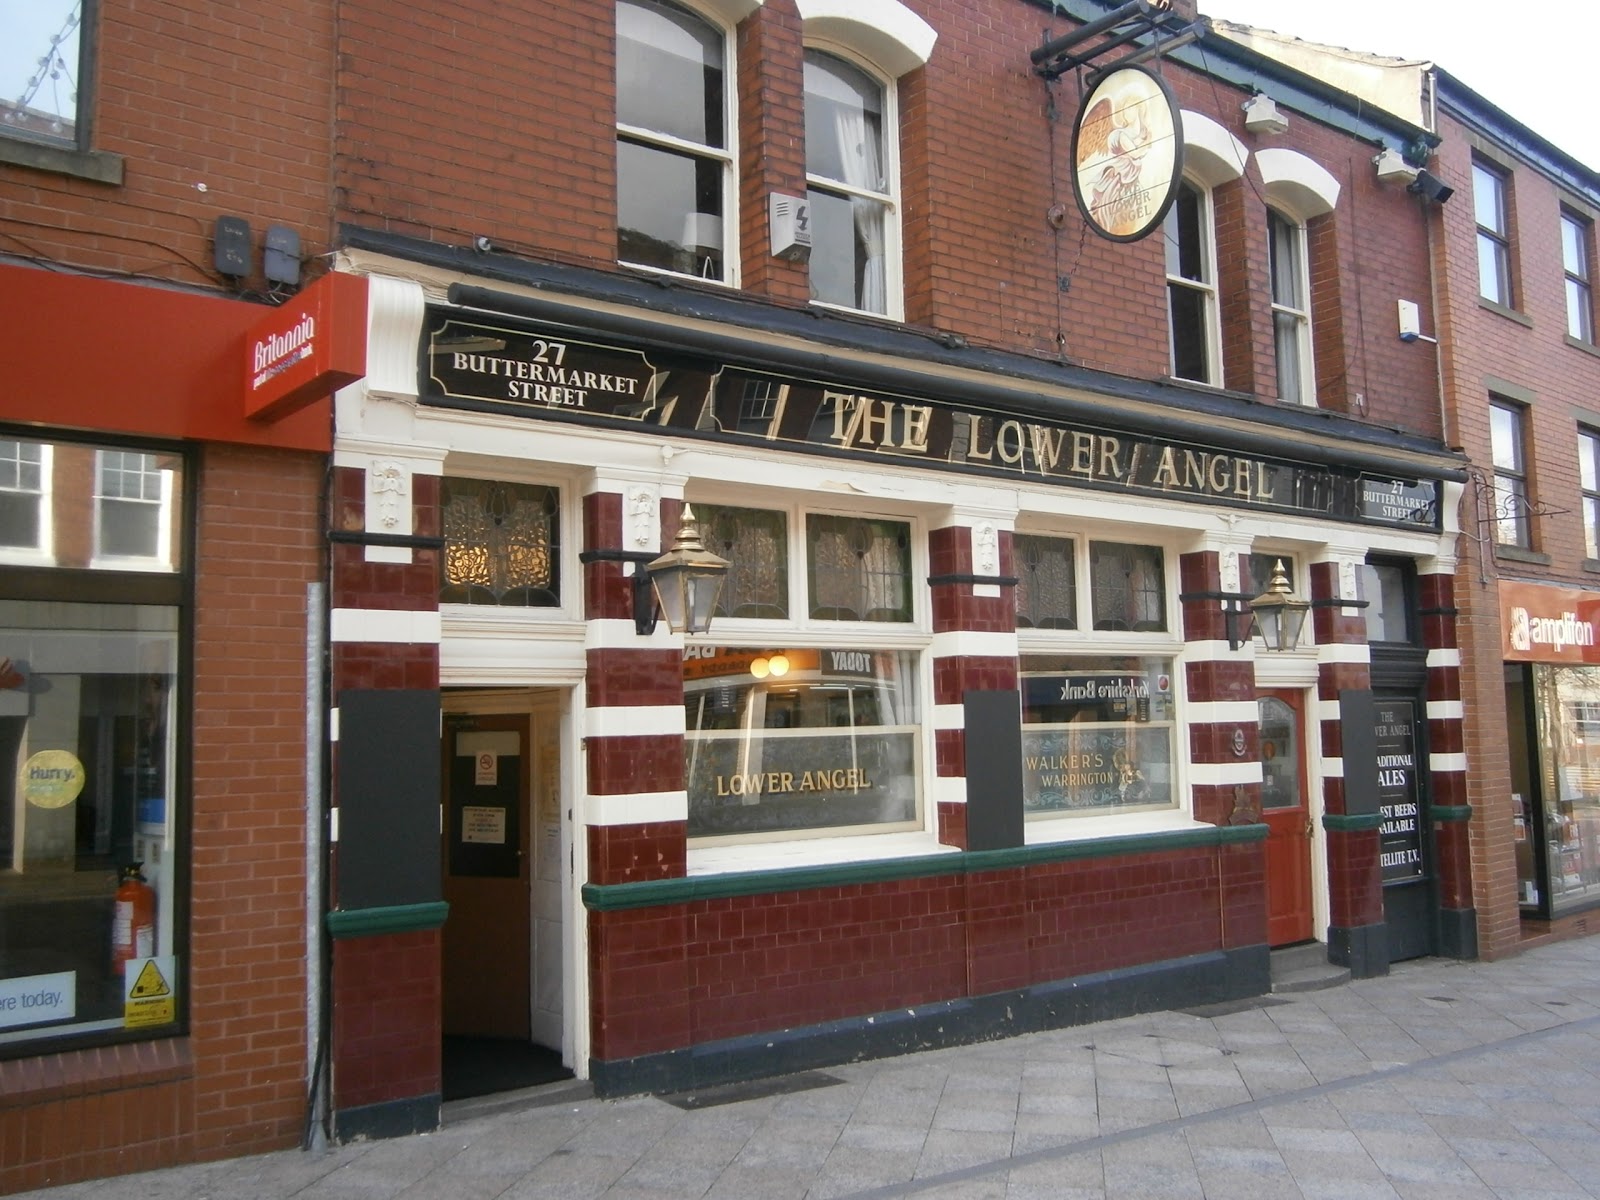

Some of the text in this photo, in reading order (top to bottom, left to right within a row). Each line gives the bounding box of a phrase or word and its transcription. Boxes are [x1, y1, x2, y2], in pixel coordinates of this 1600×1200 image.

[1112, 206, 1152, 226] ANGEL
[254, 312, 315, 373] Britannia
[532, 339, 566, 365] 27
[453, 352, 638, 395] BUTTERMARKET
[508, 381, 588, 407] STREET
[823, 389, 1275, 499] THE LOWER ANGEL
[1390, 480, 1404, 495] 27
[1363, 491, 1430, 511] BUTTERMARKET
[1382, 506, 1412, 519] STREET
[1530, 611, 1594, 653] amplifon
[1380, 711, 1394, 723] THE
[1390, 724, 1411, 736] ANGEL
[1026, 753, 1104, 771] WALKER'S
[1377, 754, 1413, 768] ADITIONAL
[717, 768, 871, 796] LOWER ANGEL
[1041, 771, 1113, 787] WARRINGTON
[1377, 769, 1406, 787] ALES
[1394, 803, 1417, 817] BEERS
[21, 989, 63, 1008] today.
